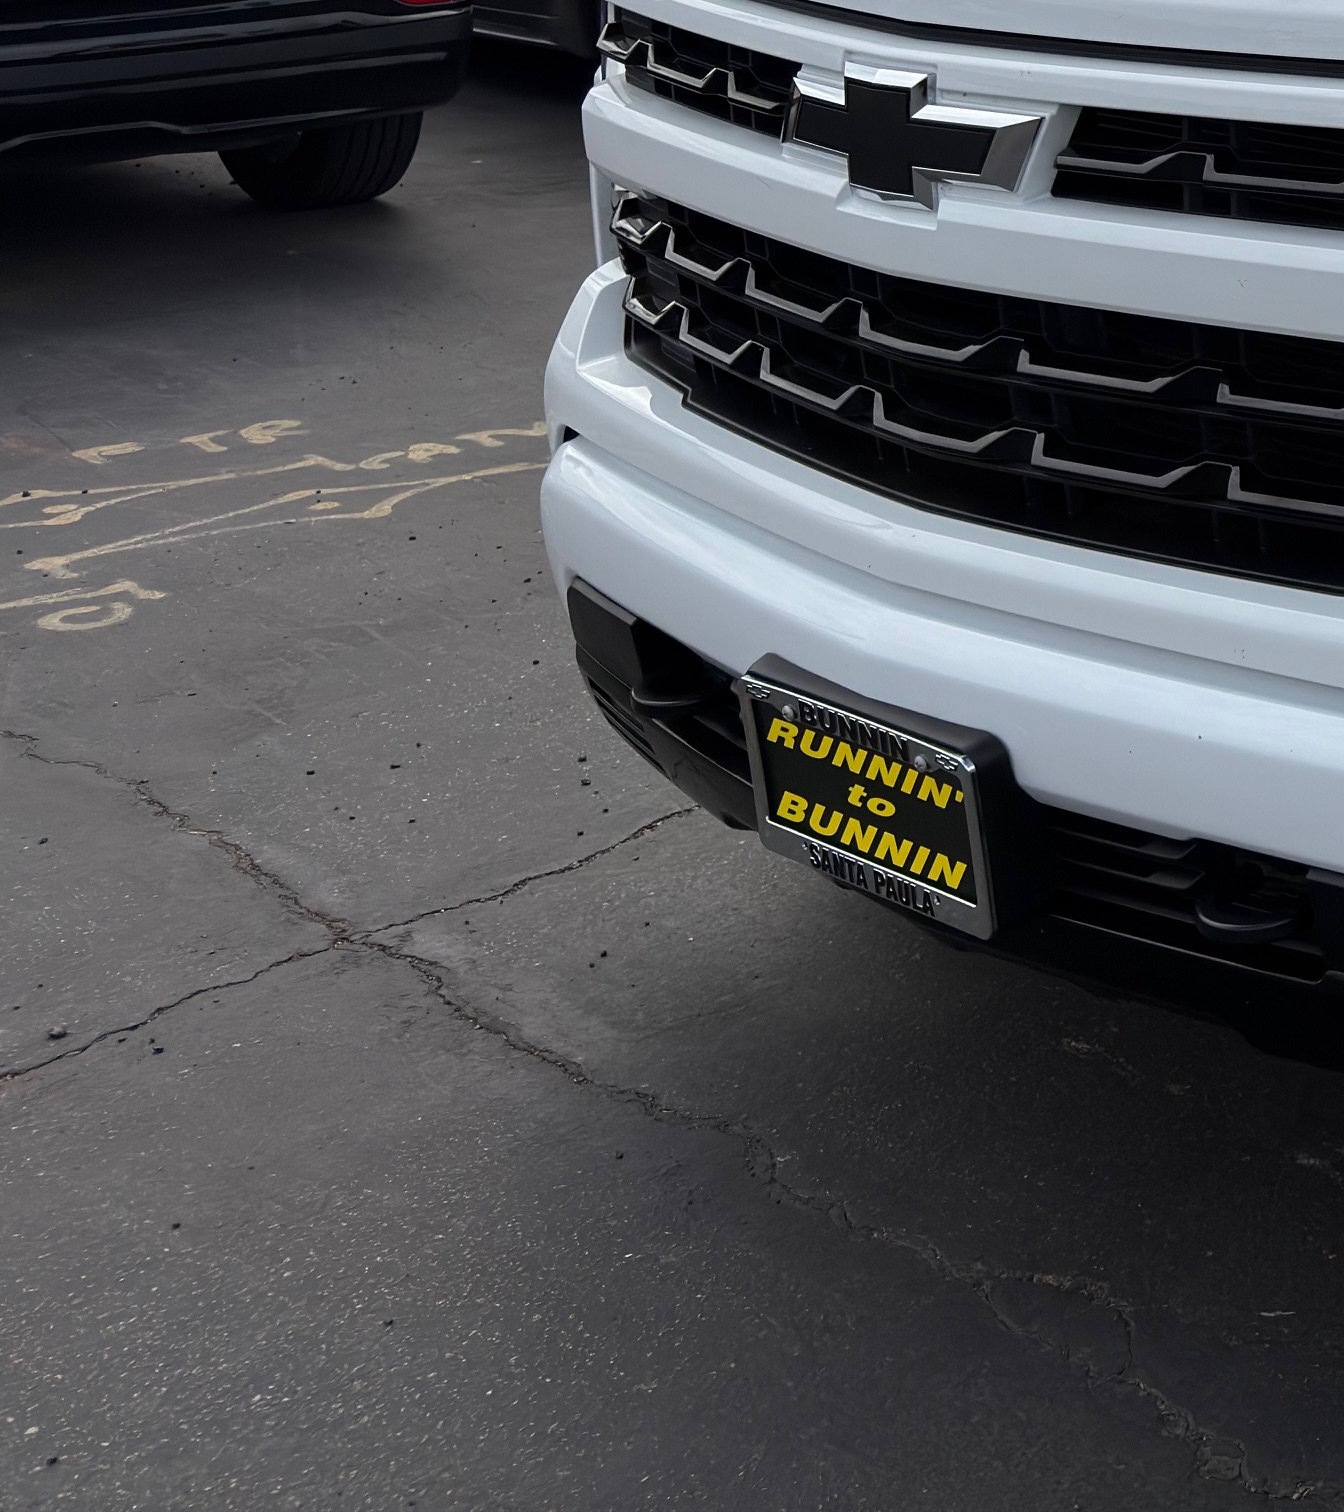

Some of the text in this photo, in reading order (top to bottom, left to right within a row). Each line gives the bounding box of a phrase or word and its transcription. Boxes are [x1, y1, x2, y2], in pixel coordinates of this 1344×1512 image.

[767, 717, 965, 810] RUNNIN'
[797, 699, 909, 761] BUNNIN
[847, 784, 896, 818] to
[776, 791, 968, 890] BUNNIN
[809, 842, 936, 916] SANTA PAULA
